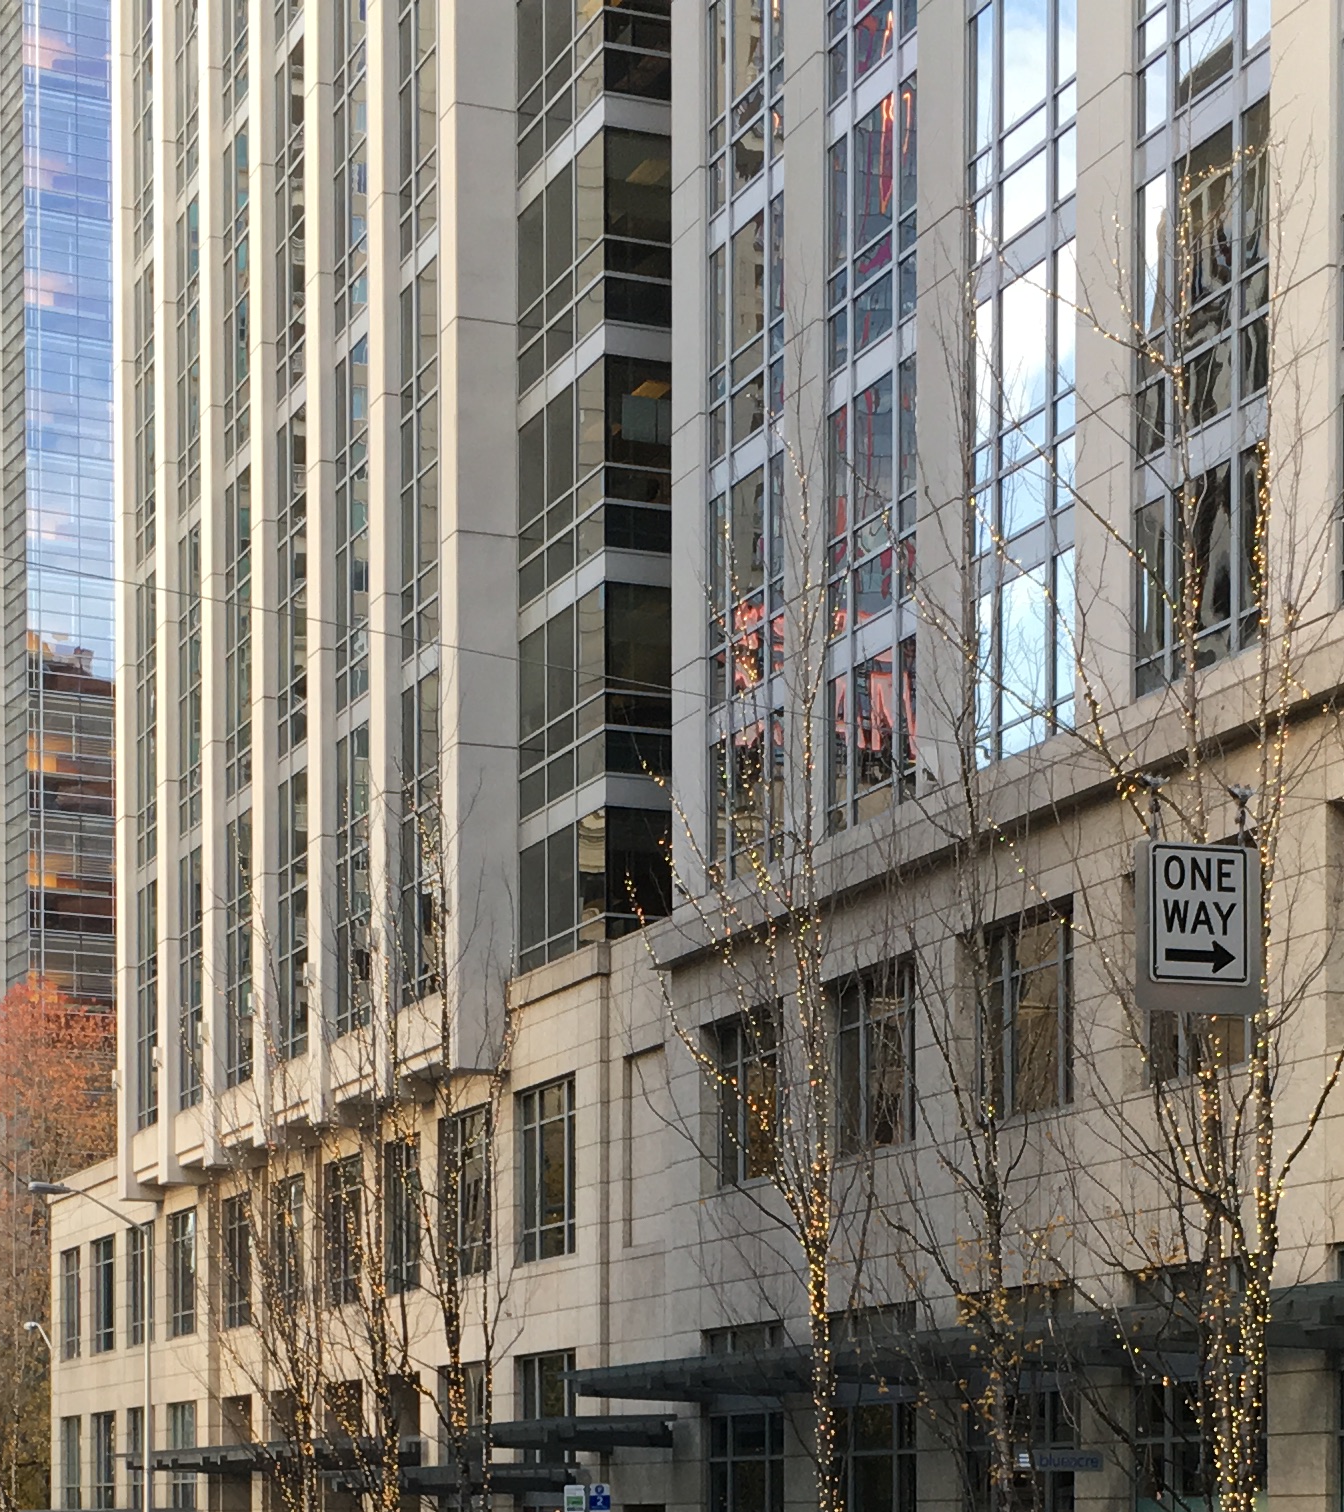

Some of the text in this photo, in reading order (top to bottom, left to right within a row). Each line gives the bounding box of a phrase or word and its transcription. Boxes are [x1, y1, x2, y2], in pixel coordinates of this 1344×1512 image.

[1163, 854, 1237, 893] ONE
[1163, 899, 1237, 936] WAY
[1039, 1452, 1099, 1469] blueacre
[597, 1496, 603, 1506] 2
